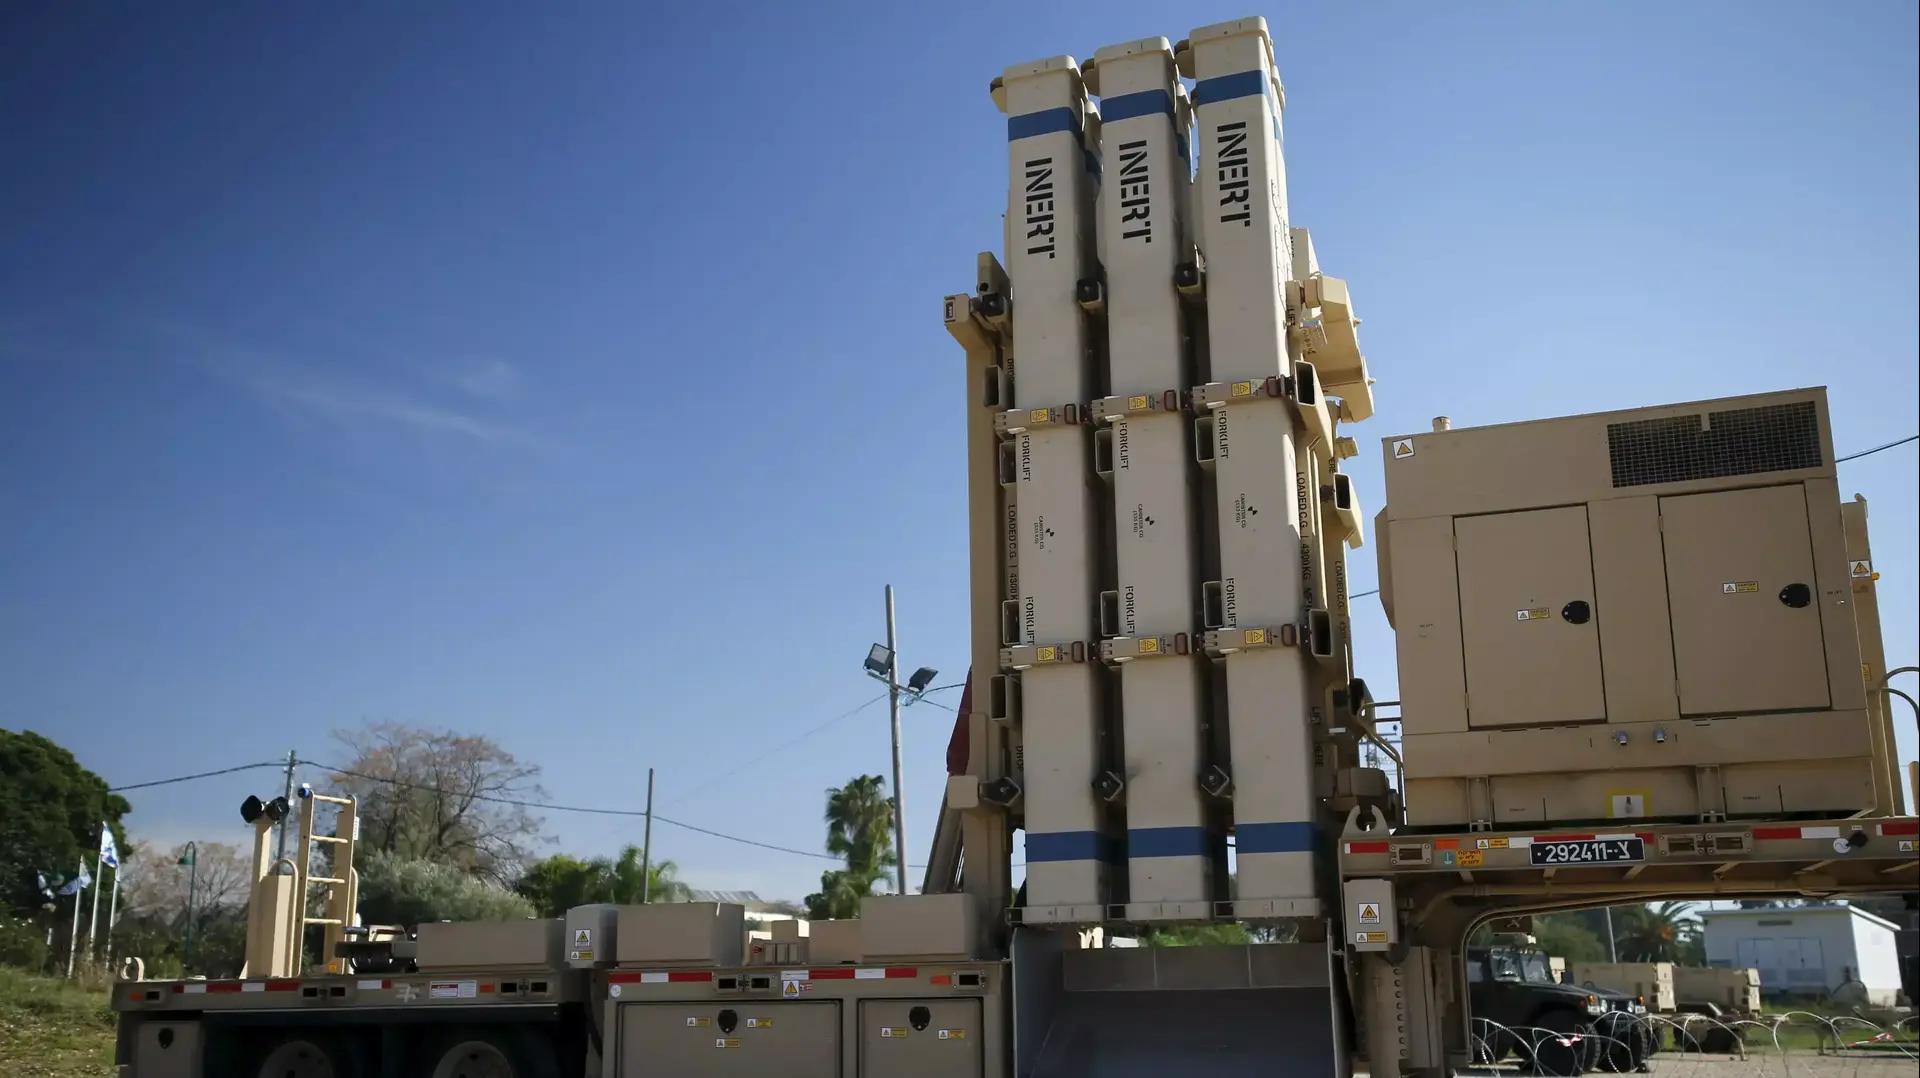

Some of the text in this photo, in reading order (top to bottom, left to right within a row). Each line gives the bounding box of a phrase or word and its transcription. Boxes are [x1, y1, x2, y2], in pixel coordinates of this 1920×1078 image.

[1119, 139, 1151, 243] INERT
[1217, 121, 1250, 227] INERT
[1025, 157, 1055, 259] INERT
[1022, 434, 1031, 482] FORKLIFT
[1119, 422, 1129, 470] FORKLIFT
[1218, 410, 1229, 459] FORKLIFT
[1296, 471, 1307, 510] LOADED
[1008, 504, 1017, 542] LOADED
[1301, 543, 1310, 565] 4300
[1302, 565, 1312, 580] KG
[1334, 560, 1344, 593] LOADED
[1009, 573, 1018, 594] 4300
[1225, 577, 1236, 628] FORKLIFT
[1025, 596, 1035, 645] FORKLIFT
[1125, 586, 1135, 635] FORKLIFT
